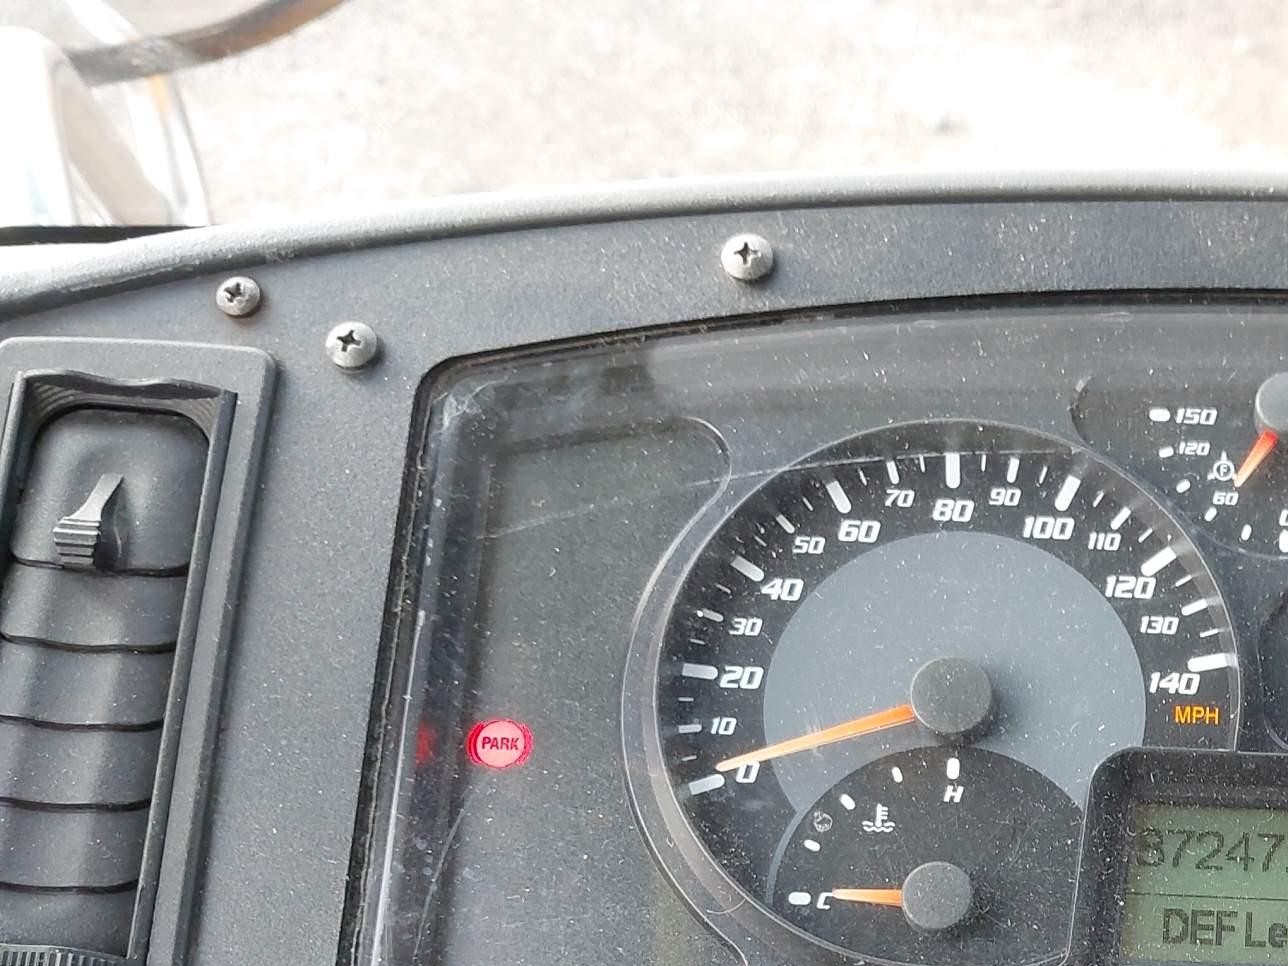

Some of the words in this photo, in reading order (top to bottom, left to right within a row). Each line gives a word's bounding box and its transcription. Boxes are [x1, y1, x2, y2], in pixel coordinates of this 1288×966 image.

[1175, 408, 1217, 426] 150
[1178, 440, 1210, 456] 120
[884, 489, 914, 507] 70
[989, 488, 1021, 507] 90
[1212, 491, 1238, 506] 60
[932, 500, 974, 522] 80
[838, 520, 880, 543] 60
[1022, 516, 1074, 541] 100
[792, 536, 825, 555] 50
[1087, 533, 1121, 551] 110
[760, 579, 801, 602] 40
[1105, 576, 1155, 599] 120
[730, 617, 762, 636] 30
[1140, 616, 1179, 635] 130
[719, 666, 763, 690] 20
[1148, 673, 1200, 695] 140
[1174, 706, 1219, 724] MPH
[711, 717, 736, 735] 10
[481, 736, 519, 750] PARK
[736, 763, 759, 783] 0
[944, 786, 964, 803] H
[1163, 907, 1238, 946] DEF
